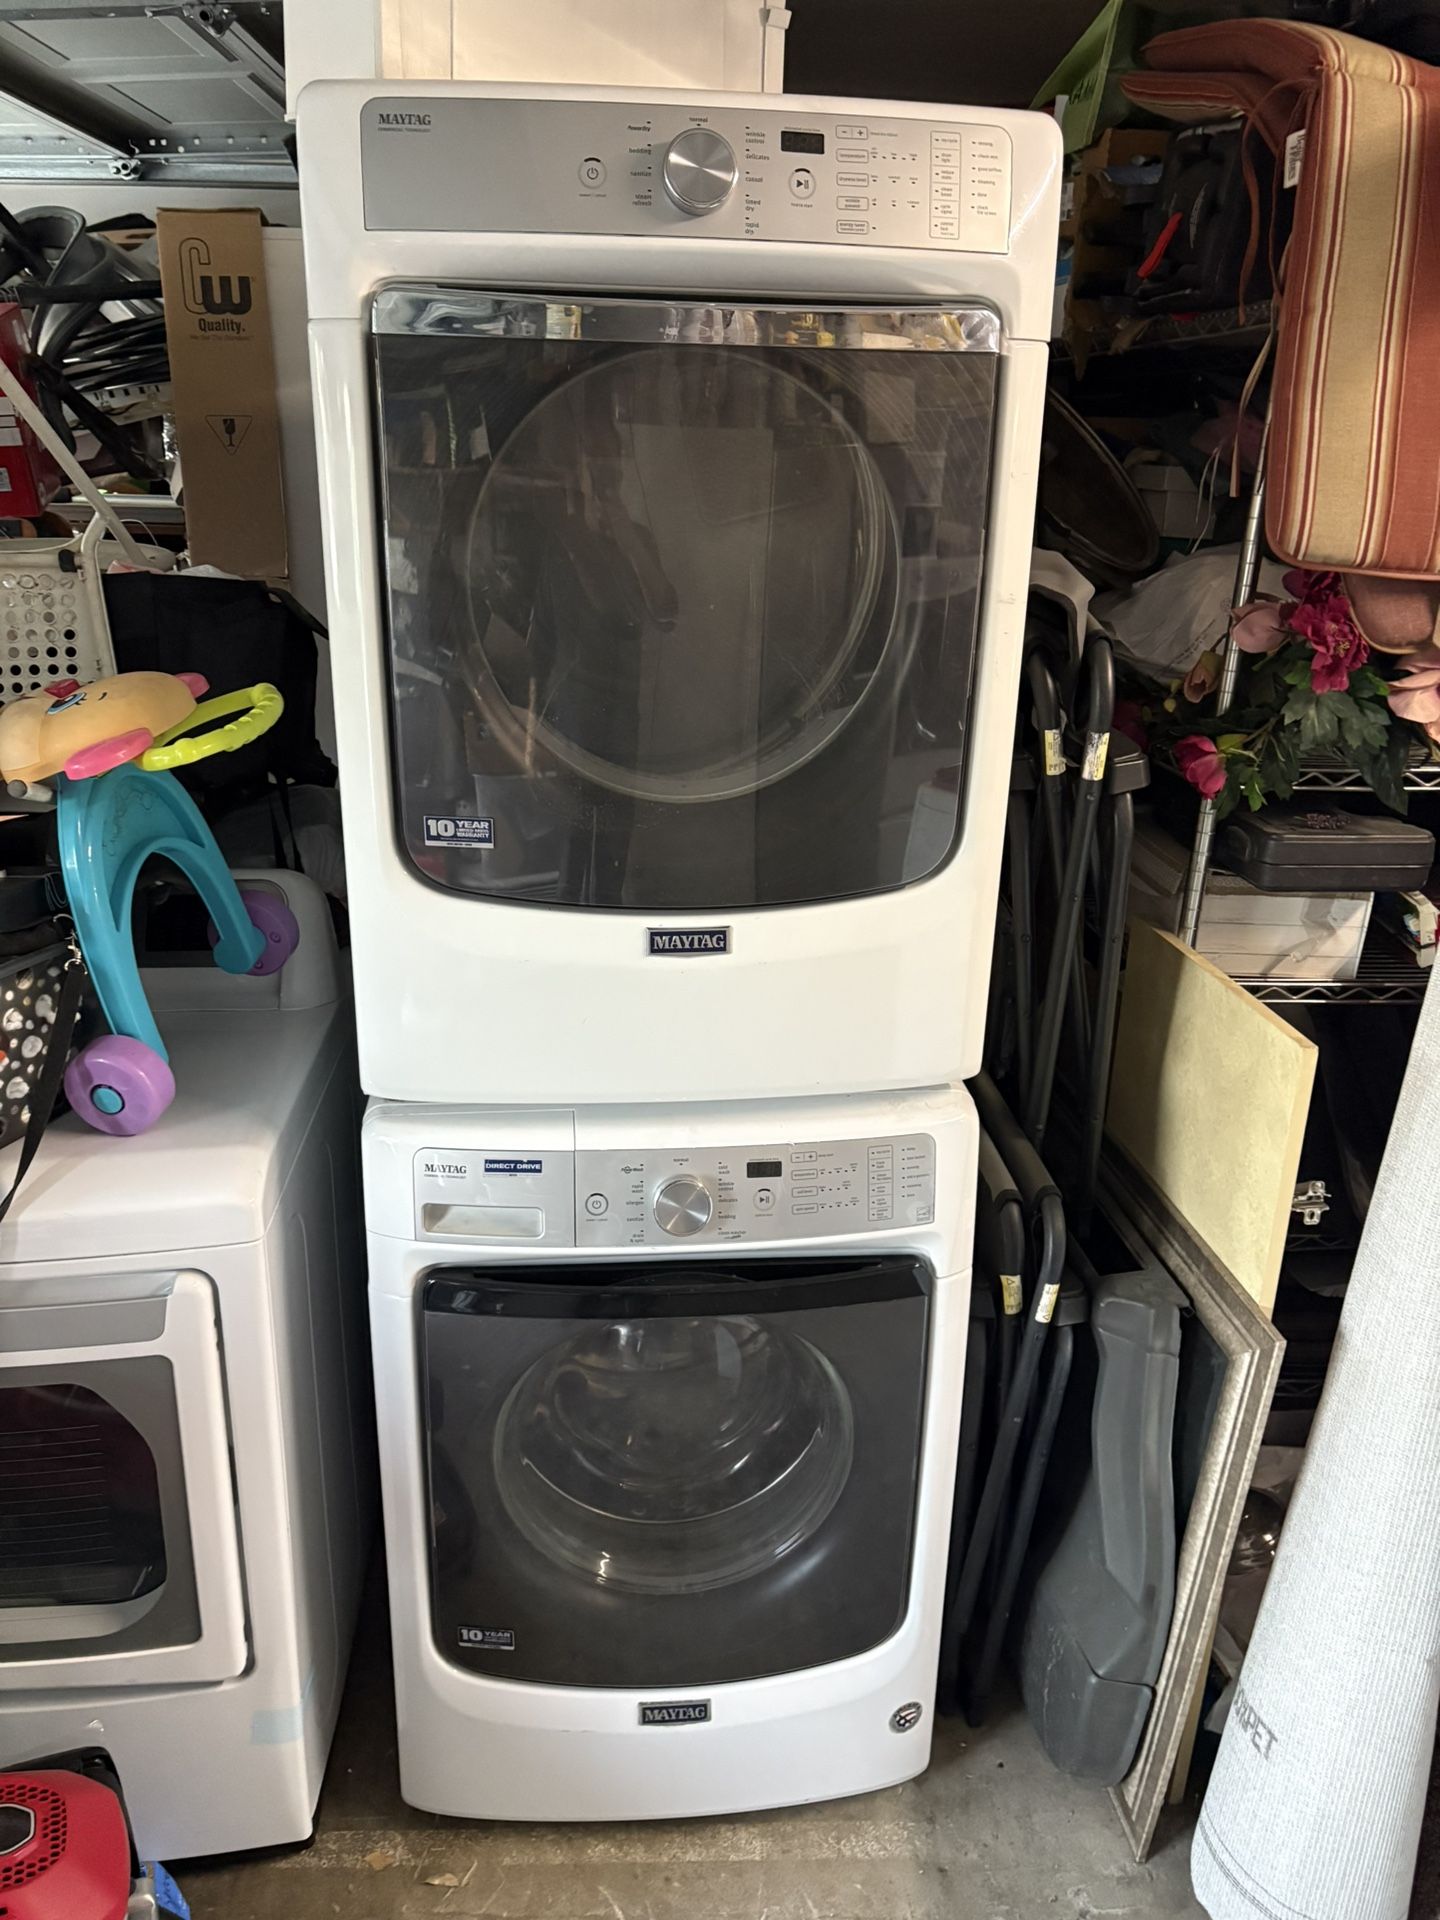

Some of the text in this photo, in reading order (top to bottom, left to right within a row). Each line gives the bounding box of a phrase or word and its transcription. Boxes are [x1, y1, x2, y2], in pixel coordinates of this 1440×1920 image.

[378, 113, 432, 126] MAYTAG
[198, 317, 246, 334] Quality.
[427, 819, 490, 837] 10 YEAR
[652, 933, 726, 950] MAYTAG
[424, 1163, 467, 1174] MAYTAG
[461, 1629, 483, 1641] 10
[644, 1705, 706, 1722] MAYTAG
